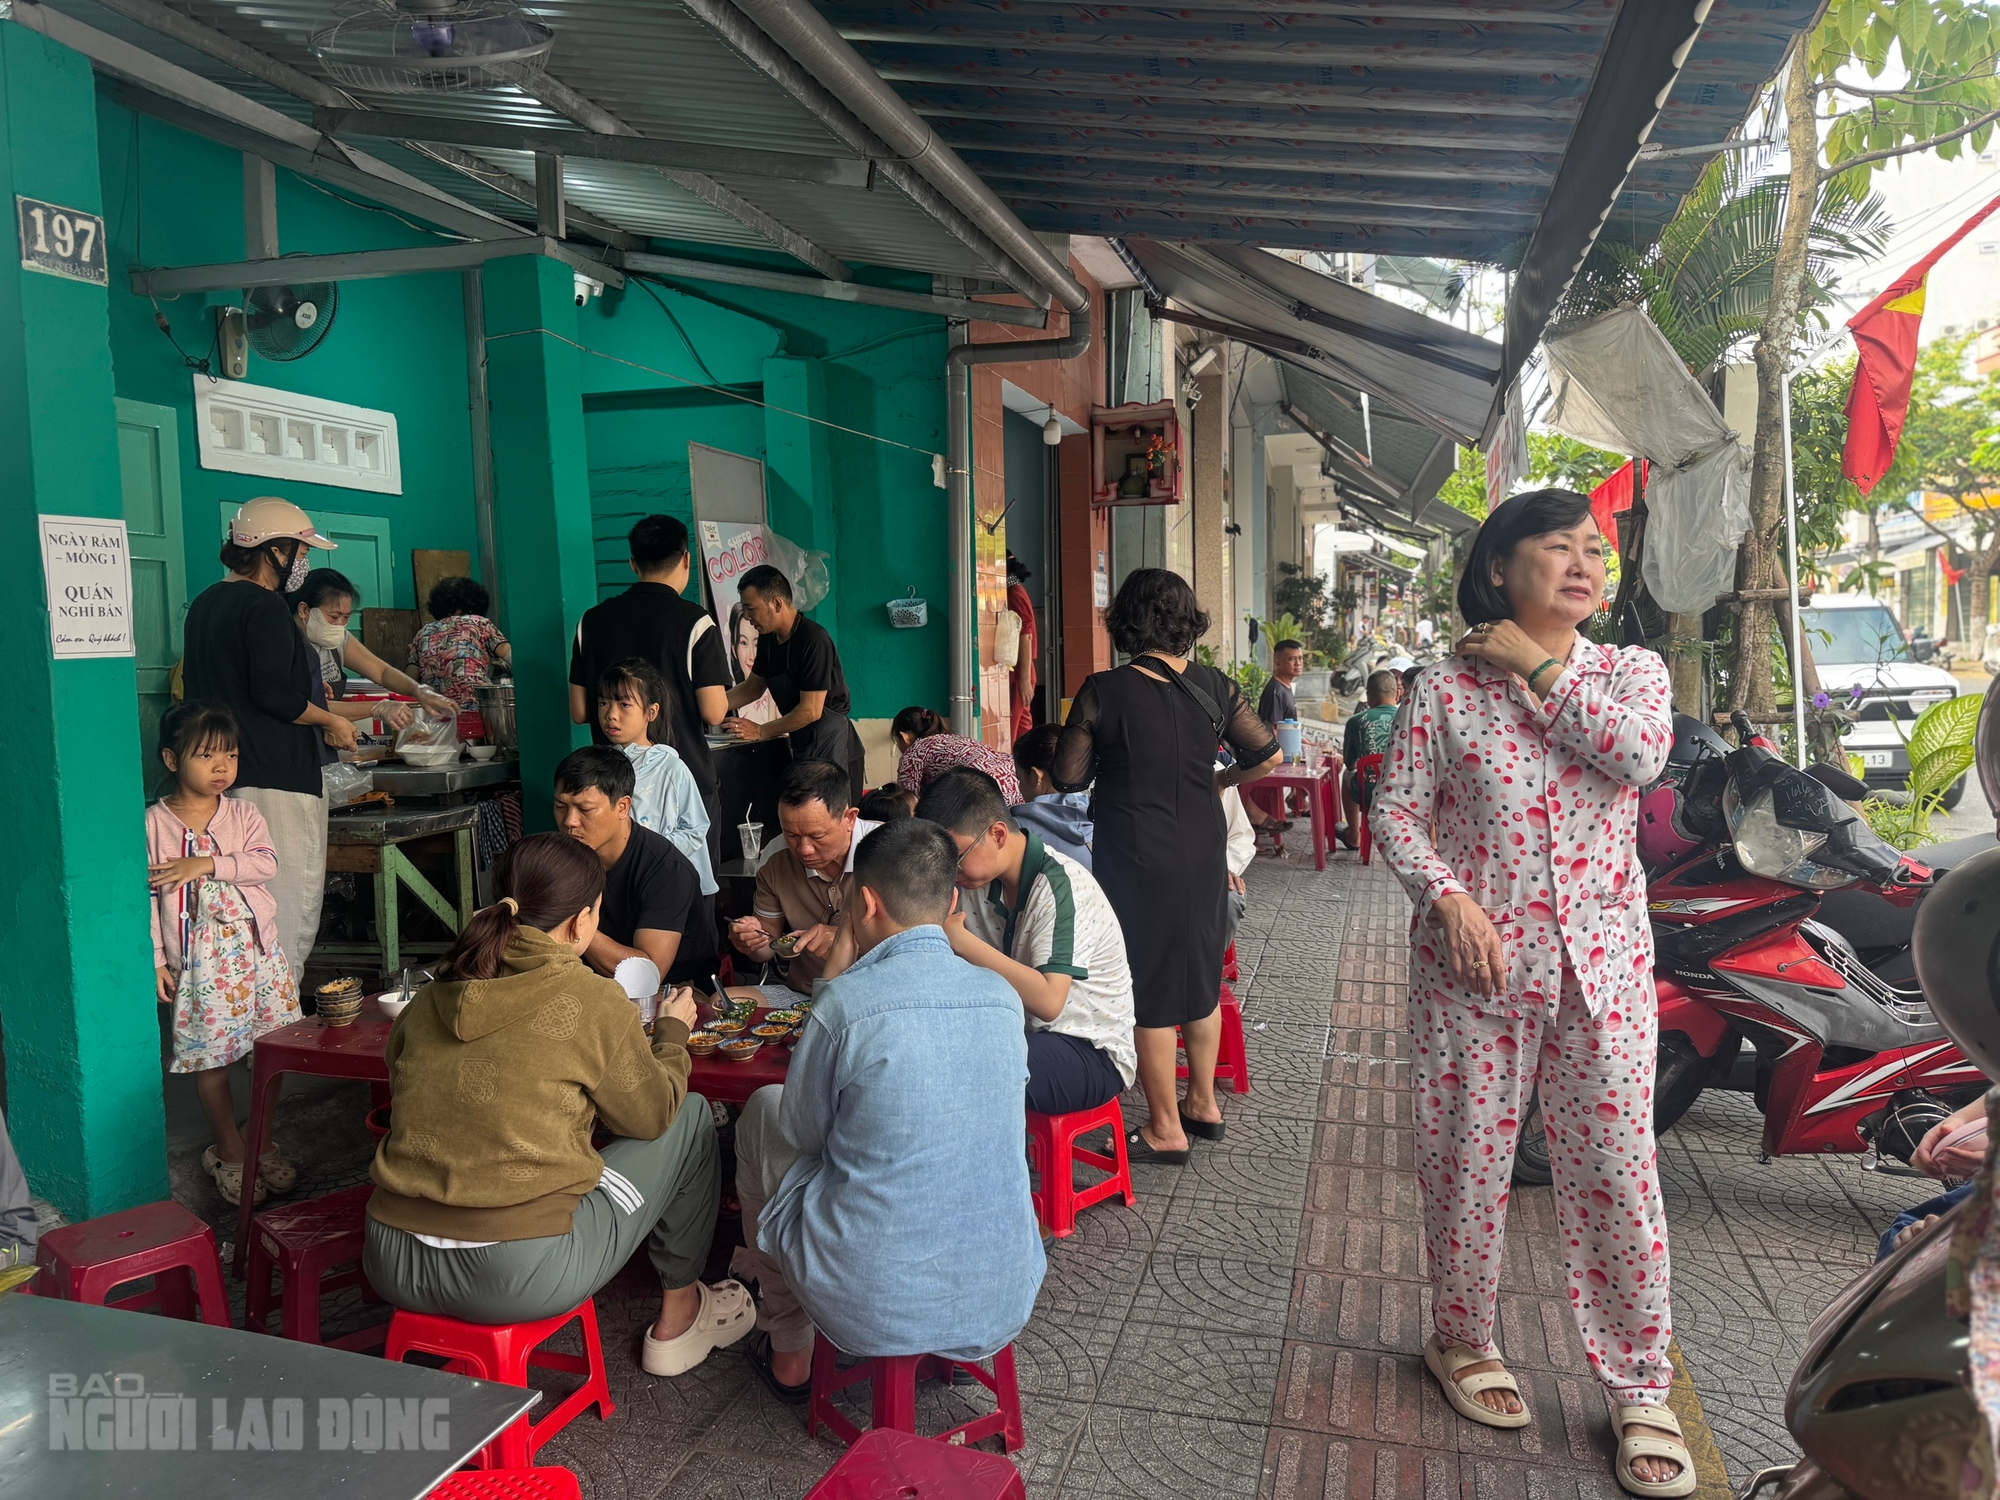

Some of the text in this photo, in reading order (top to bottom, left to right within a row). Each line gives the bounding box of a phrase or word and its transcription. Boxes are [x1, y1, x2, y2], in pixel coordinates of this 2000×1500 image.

[1052, 14, 1066, 33] TATA
[1231, 22, 1245, 41] TATA
[1146, 57, 1161, 76] TATA
[1321, 66, 1333, 85] TATA
[1504, 74, 1519, 94] TATA
[30, 207, 95, 262] 197
[1210, 222, 1219, 239] TATA
[48, 531, 88, 547] NGÀY
[111, 554, 116, 565] 1
[708, 536, 768, 583] COLOR
[65, 582, 113, 603] QUÁN
[59, 603, 123, 618] NGHỈ BÁN
[1674, 969, 1716, 980] HONDA
